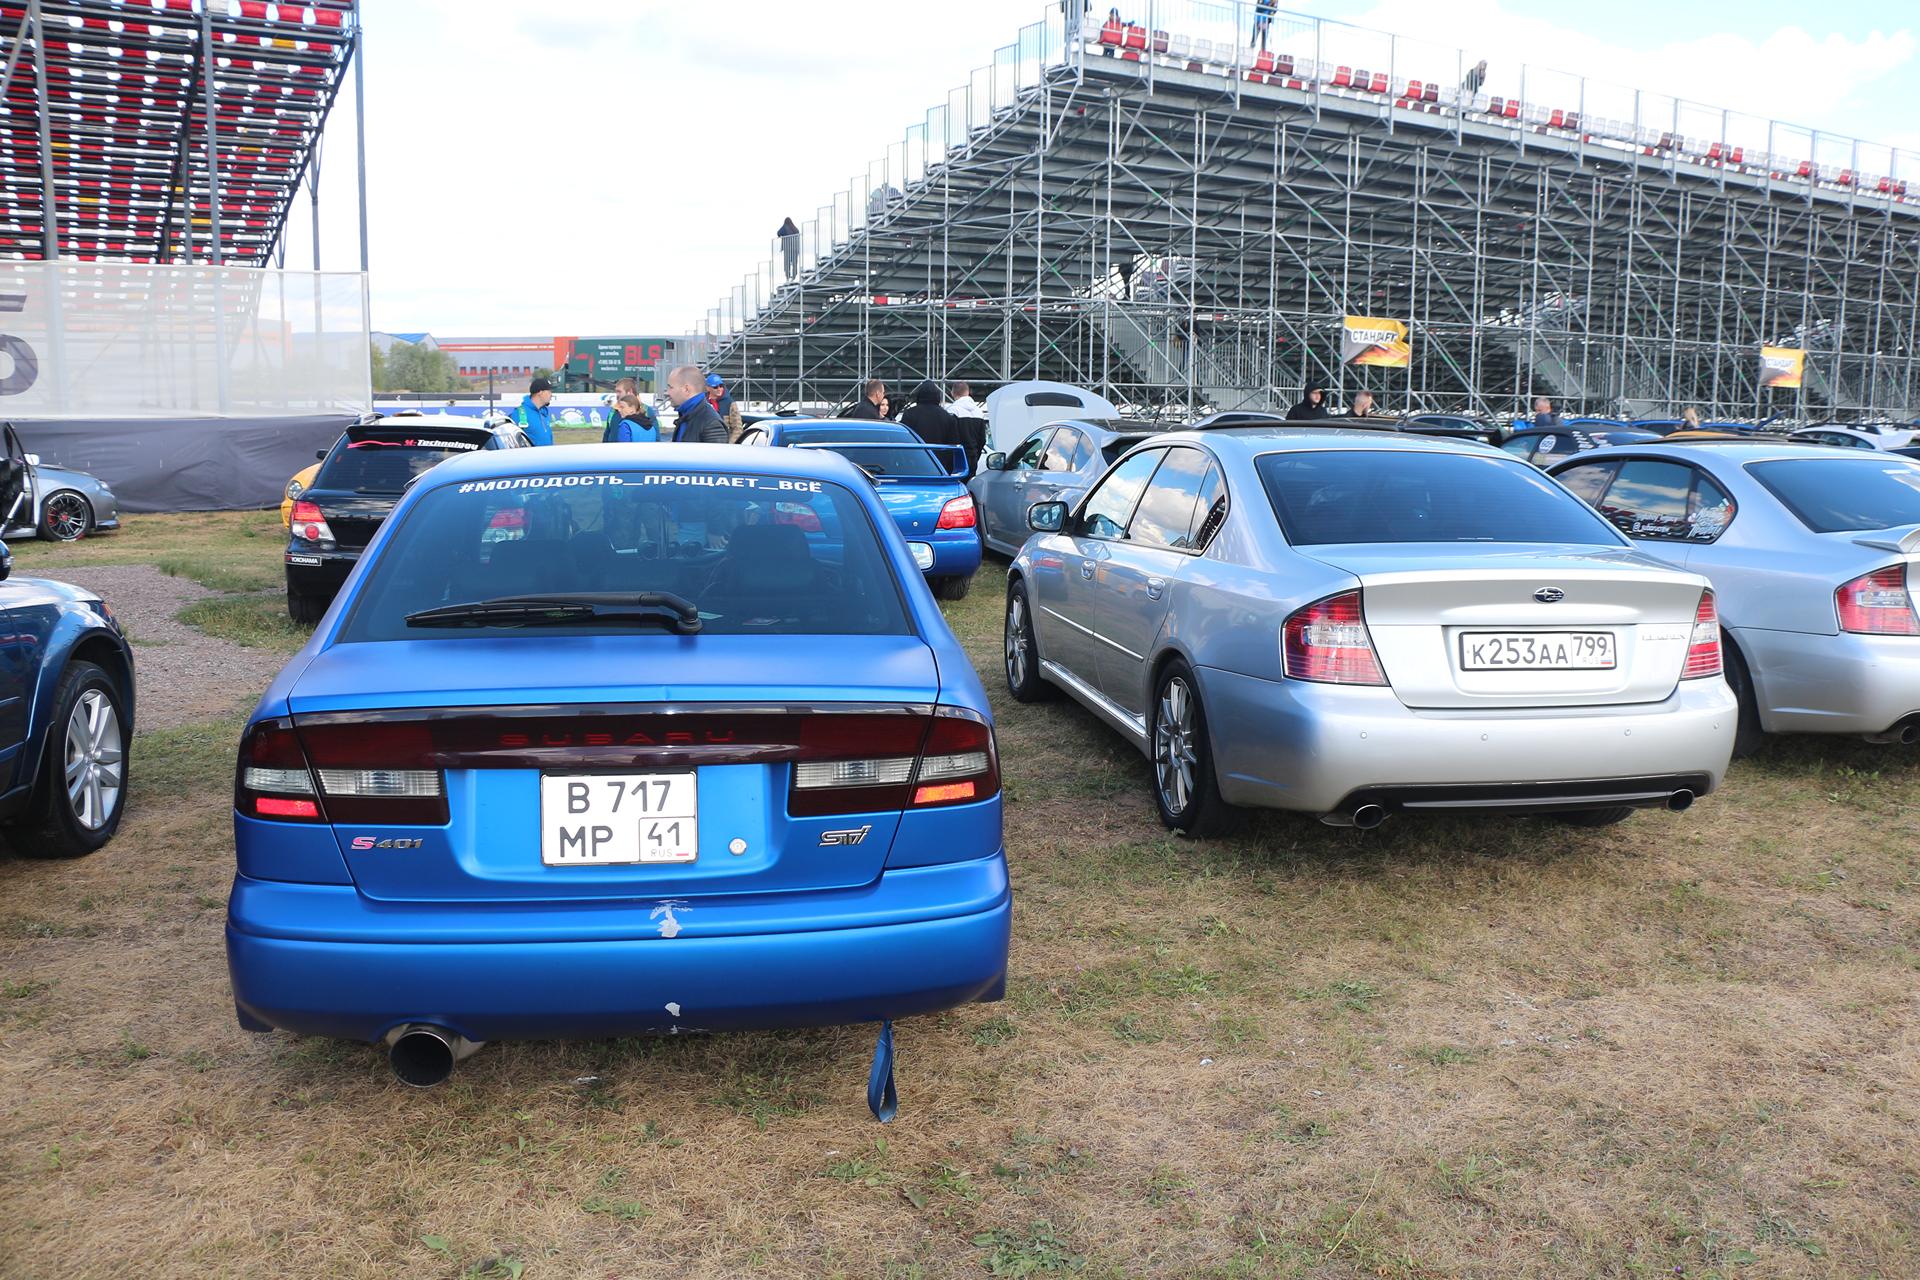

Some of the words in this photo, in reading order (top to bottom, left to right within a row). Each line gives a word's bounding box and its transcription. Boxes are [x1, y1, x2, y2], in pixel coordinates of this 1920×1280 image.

[625, 344, 662, 366] BLS
[1573, 636, 1608, 657] 799
[500, 730, 735, 746] SUBARU
[606, 780, 671, 813] 717
[351, 836, 423, 850] S401
[647, 821, 680, 847] 41
[650, 848, 673, 858] RUS
